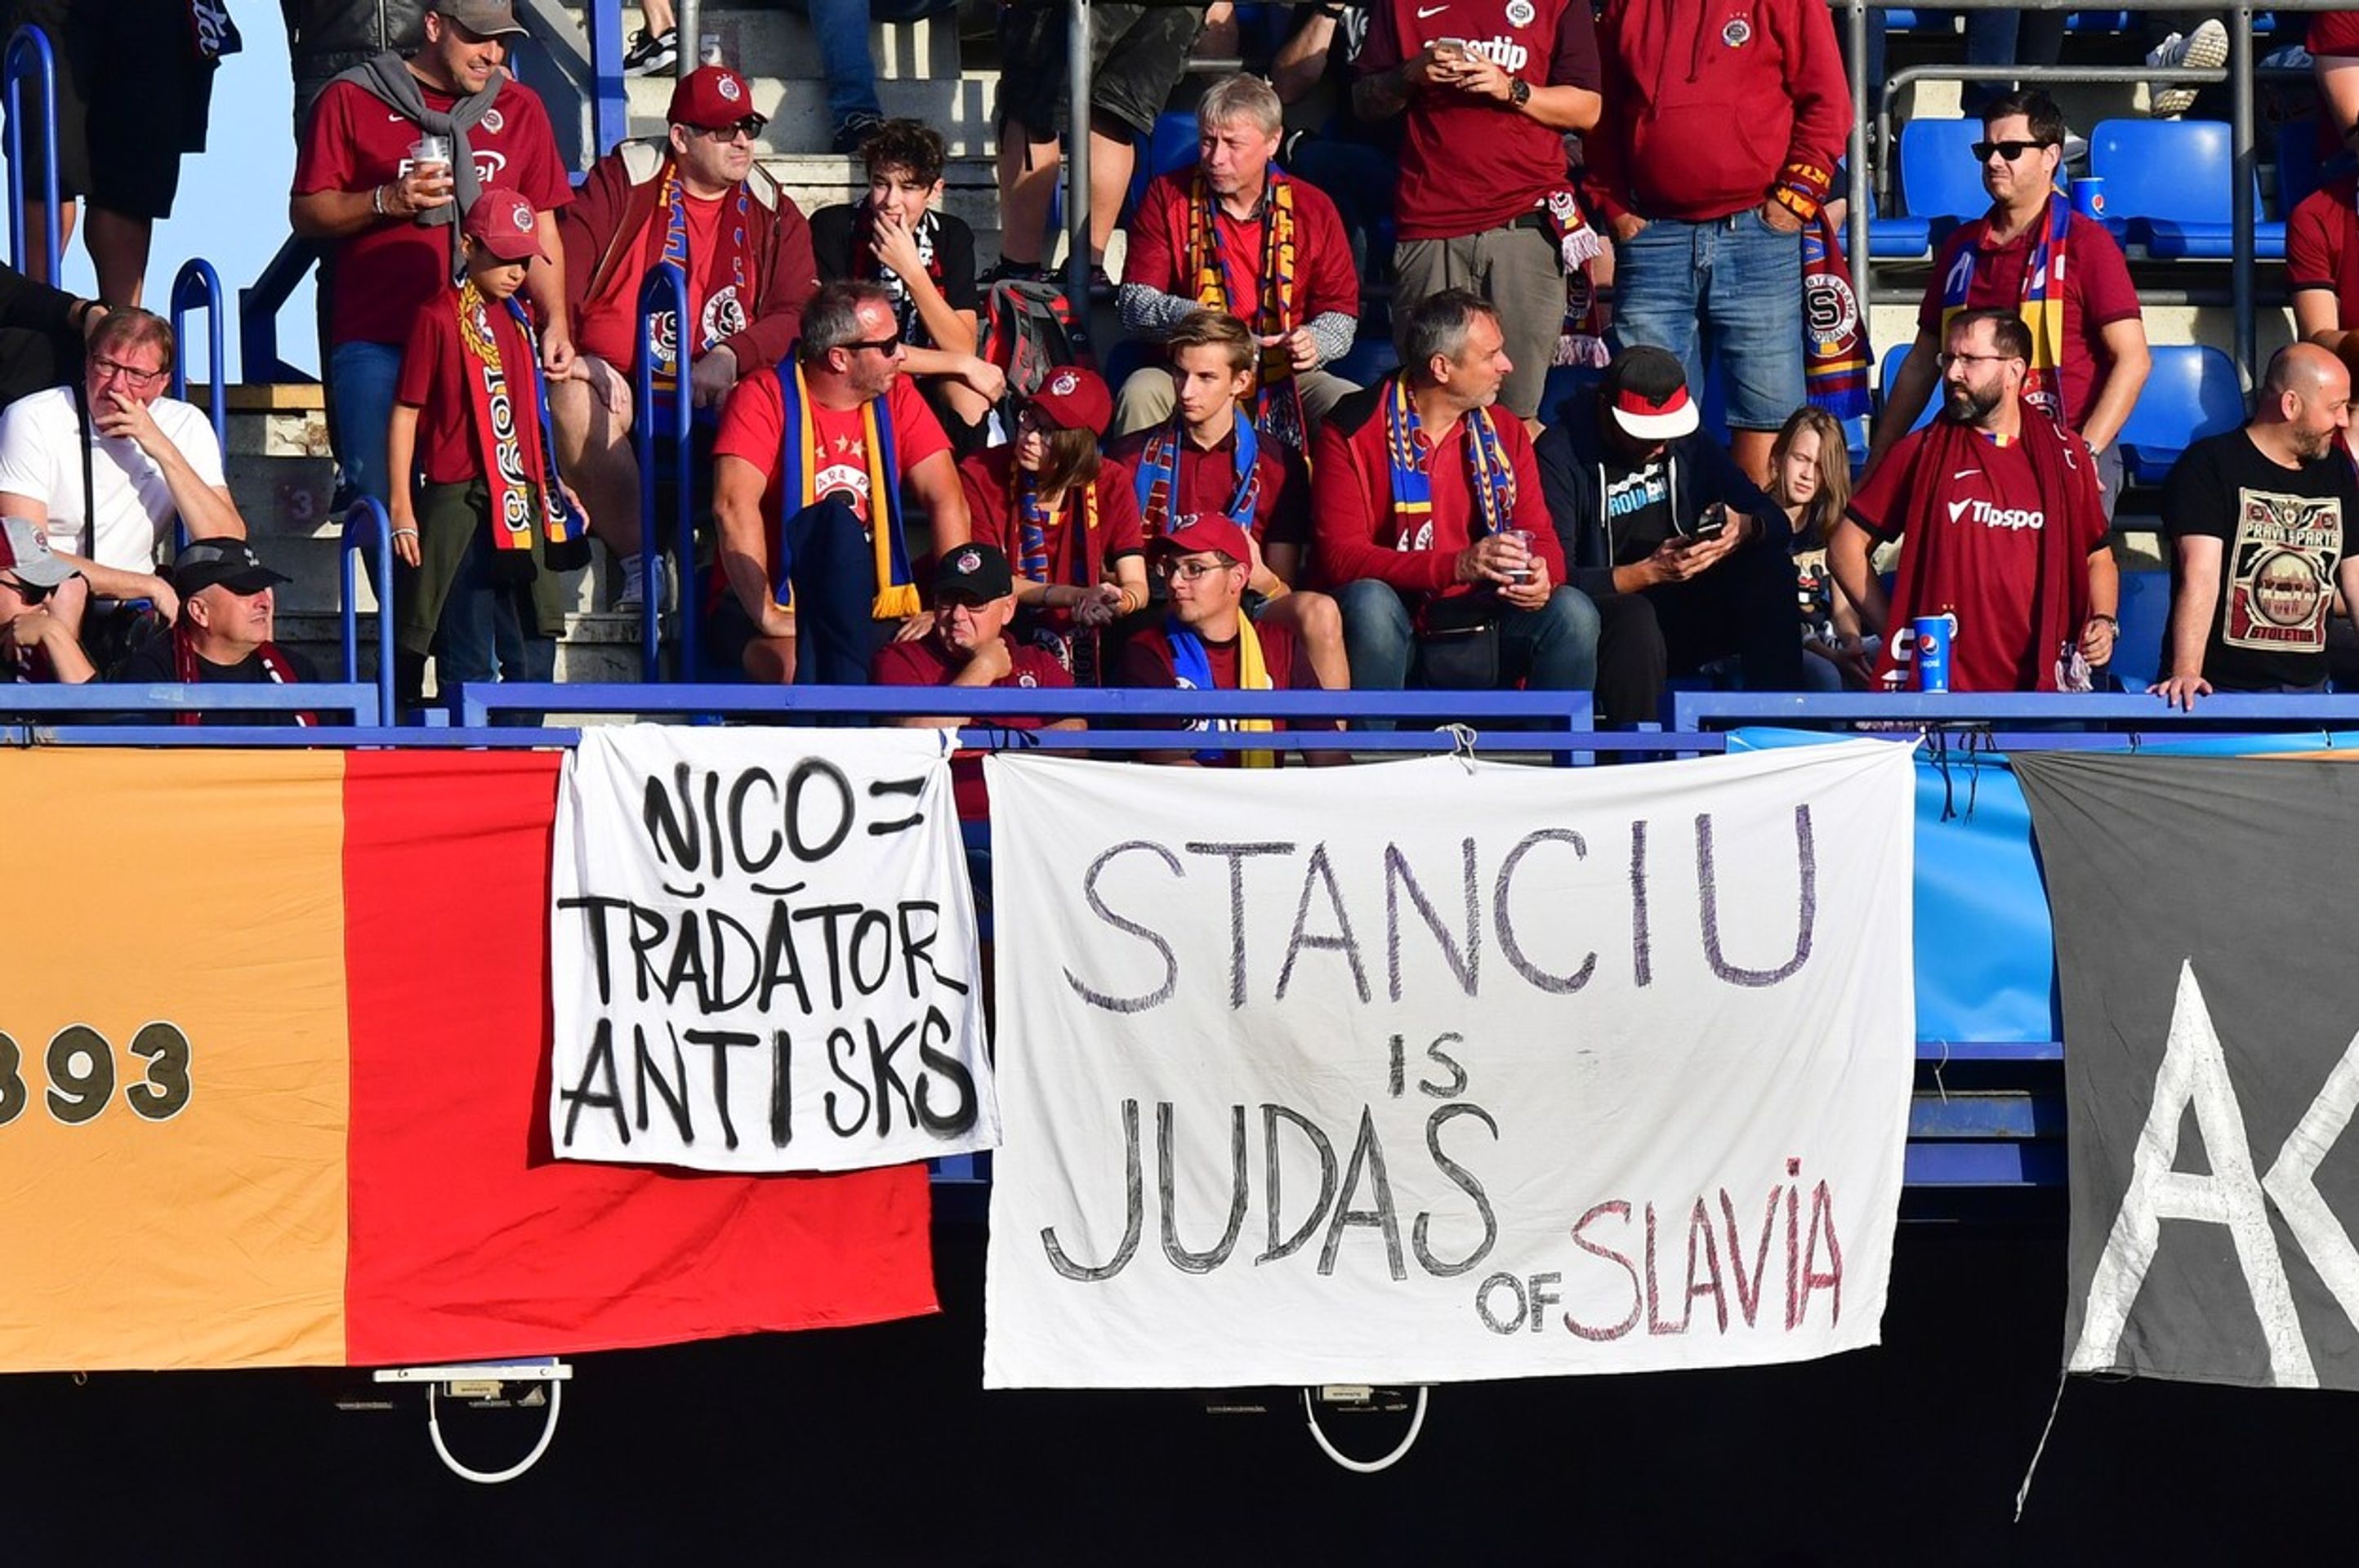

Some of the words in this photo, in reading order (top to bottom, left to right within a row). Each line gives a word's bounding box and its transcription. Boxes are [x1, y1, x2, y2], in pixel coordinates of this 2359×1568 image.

[1063, 804, 1817, 1014] STANCIU
[560, 1018, 792, 1150] ANTI
[823, 1005, 979, 1141] SKS
[1389, 1032, 1469, 1098] IS
[1040, 1098, 1499, 1282] JUDAS
[1476, 1272, 1563, 1336] OF
